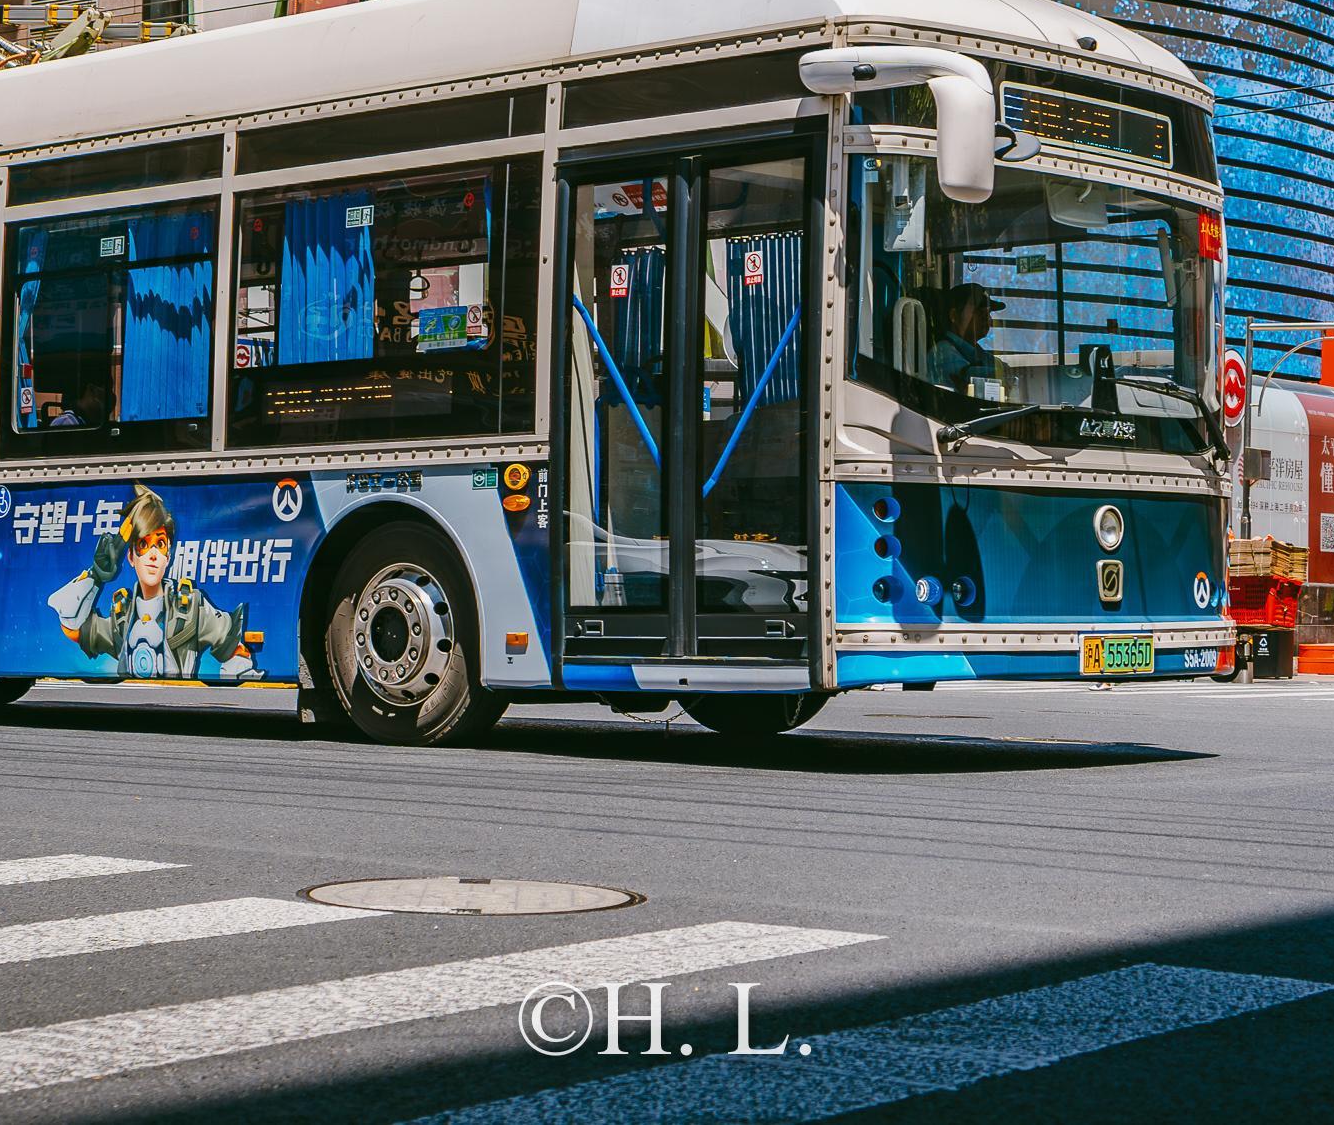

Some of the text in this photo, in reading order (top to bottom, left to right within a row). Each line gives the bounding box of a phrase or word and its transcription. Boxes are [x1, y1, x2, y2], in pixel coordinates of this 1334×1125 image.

[537, 467, 548, 529] 前门上客
[13, 499, 125, 544] 守望十年
[169, 538, 293, 583] 相伴出行
[1107, 642, 1151, 668] 55365D
